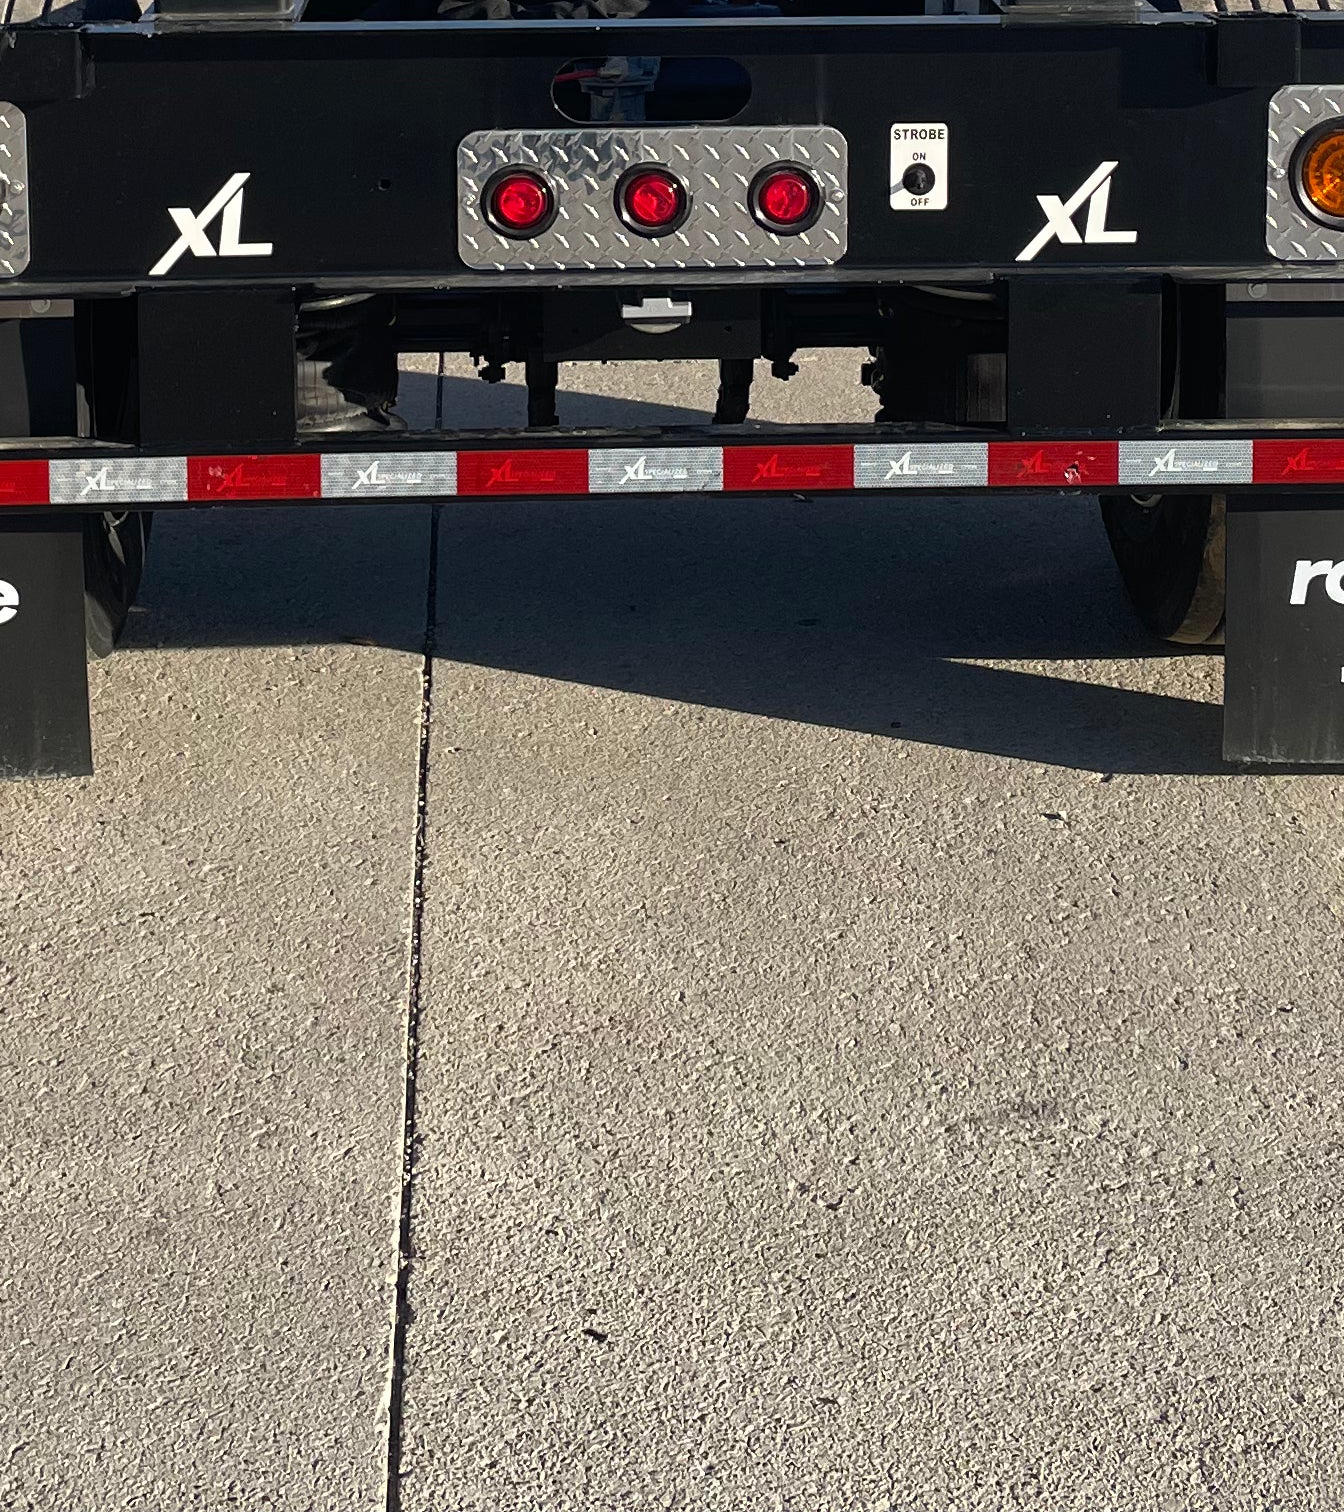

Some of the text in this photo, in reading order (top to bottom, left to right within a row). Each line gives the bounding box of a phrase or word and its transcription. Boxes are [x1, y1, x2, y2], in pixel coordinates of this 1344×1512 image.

[893, 128, 945, 141] STROBE
[912, 152, 926, 161] ON
[910, 197, 930, 207] OFF
[1015, 160, 1138, 262] XL
[149, 172, 273, 276] XL
[351, 460, 385, 489] XL
[618, 455, 652, 484] XL
[884, 451, 917, 480] XL
[1148, 448, 1182, 477] XL
[80, 467, 114, 496] XL
